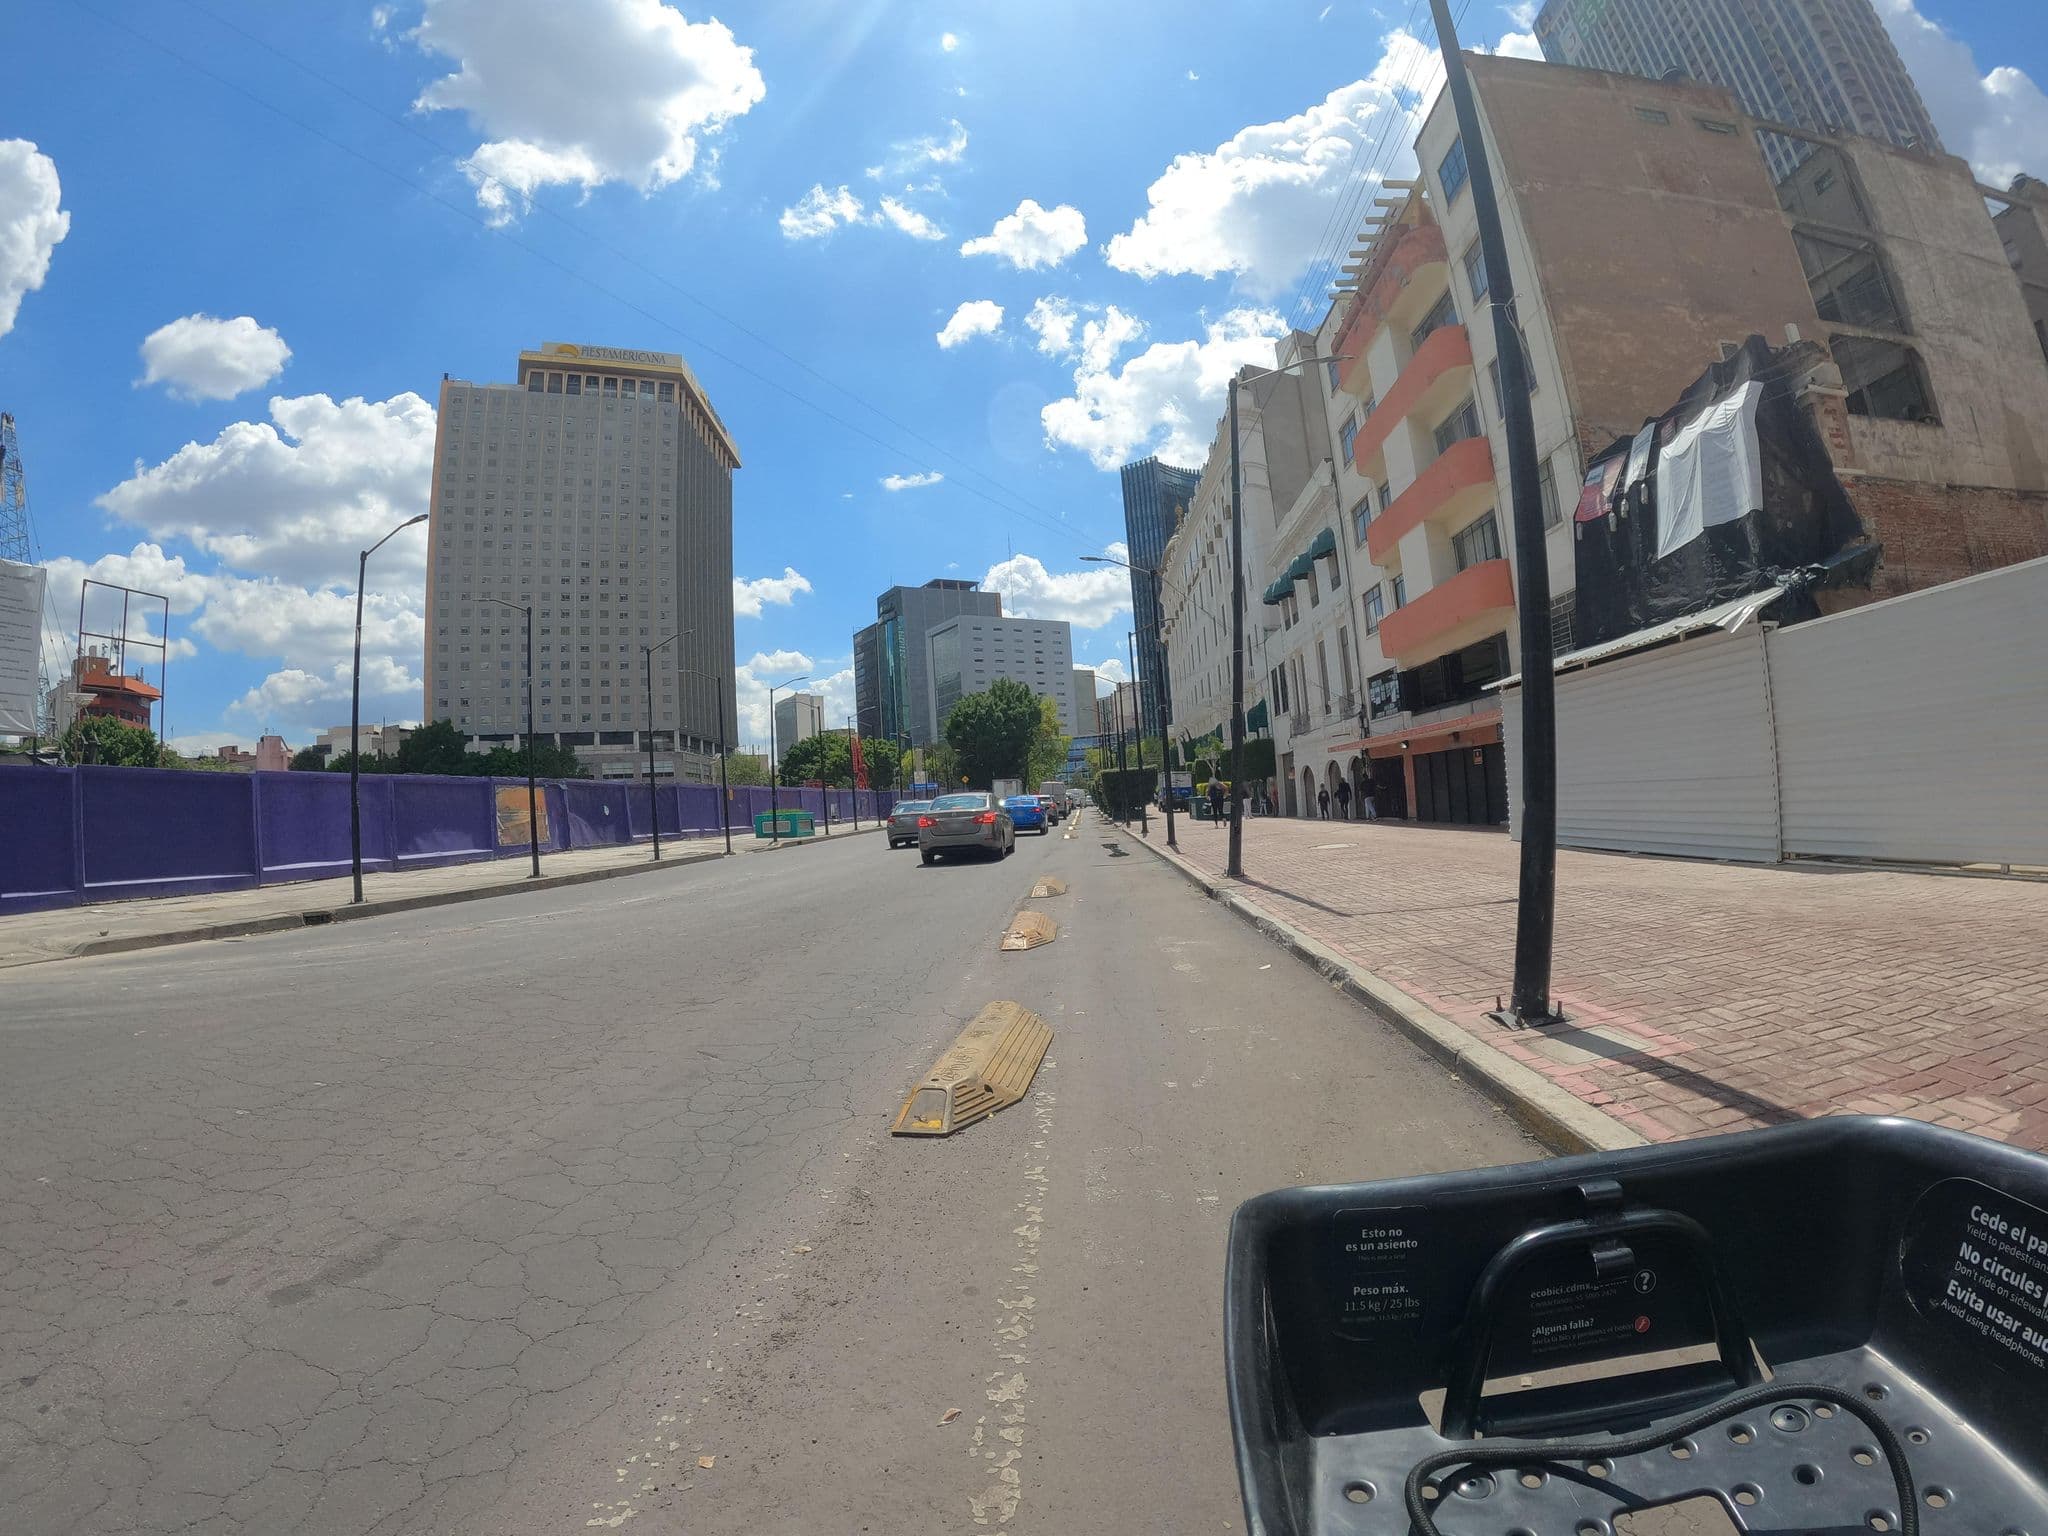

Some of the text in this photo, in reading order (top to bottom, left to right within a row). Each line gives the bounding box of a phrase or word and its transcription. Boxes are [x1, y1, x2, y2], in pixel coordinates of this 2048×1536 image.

[1361, 1228, 1403, 1239] Esto no
[1966, 1222, 1987, 1241] Yield
[1987, 1233, 1998, 1247] to
[1970, 1205, 2048, 1258] Cede el pa
[1345, 1239, 1418, 1252] es un asiento
[1954, 1260, 1978, 1281] Don't
[1978, 1272, 1997, 1291] ride
[1996, 1284, 2009, 1299] on
[1959, 1241, 1981, 1265] No
[1982, 1256, 2044, 1299] circules
[1353, 1282, 1409, 1296] Peso máx.
[1344, 1301, 1366, 1312] 11.5
[1368, 1300, 1381, 1313] kg
[1390, 1298, 1402, 1309] 25
[1405, 1297, 1420, 1308] lbs
[1946, 1279, 1985, 1313] Evita
[1985, 1304, 2022, 1333] usar
[1531, 1323, 1568, 1338] ¿Alguna
[1569, 1317, 1594, 1331] falla?
[1941, 1298, 2045, 1369] Avoid using headphones.
